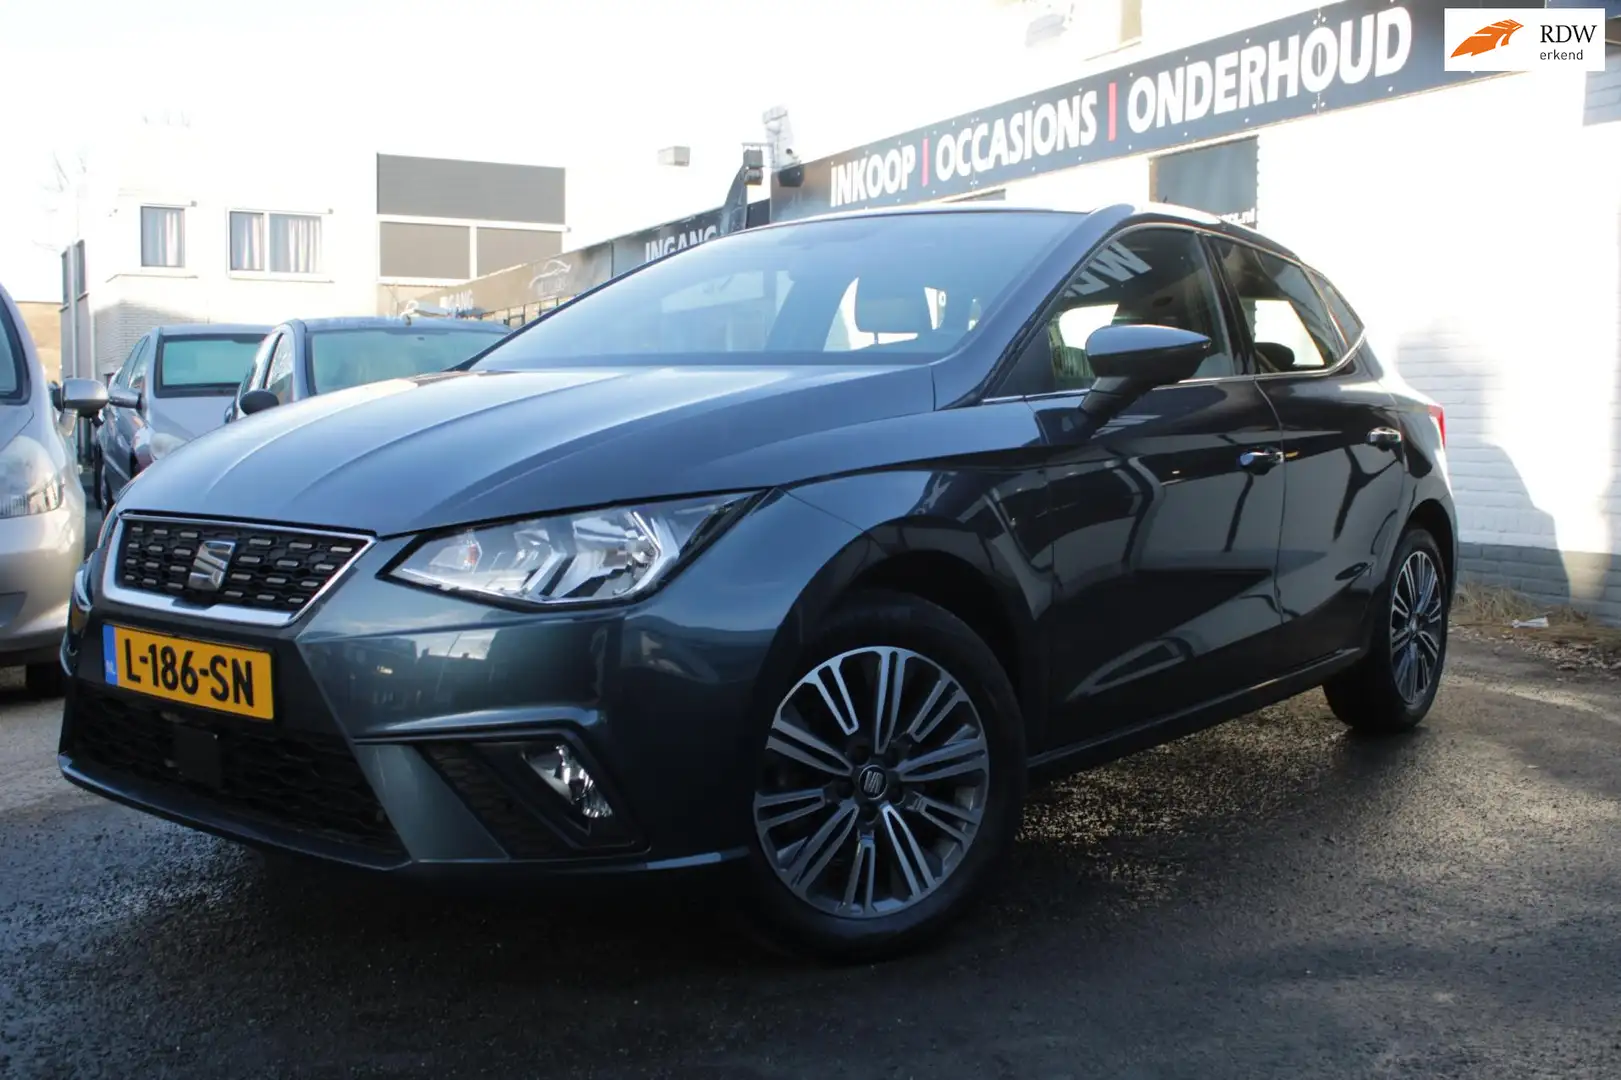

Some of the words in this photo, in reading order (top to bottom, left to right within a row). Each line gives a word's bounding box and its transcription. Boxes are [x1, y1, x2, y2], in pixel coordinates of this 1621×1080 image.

[829, 143, 917, 208] INKOOP
[935, 90, 1098, 182] OCCASIONS
[1127, 6, 1413, 134] ONDERHOUD
[124, 638, 254, 708] L-186-SN
